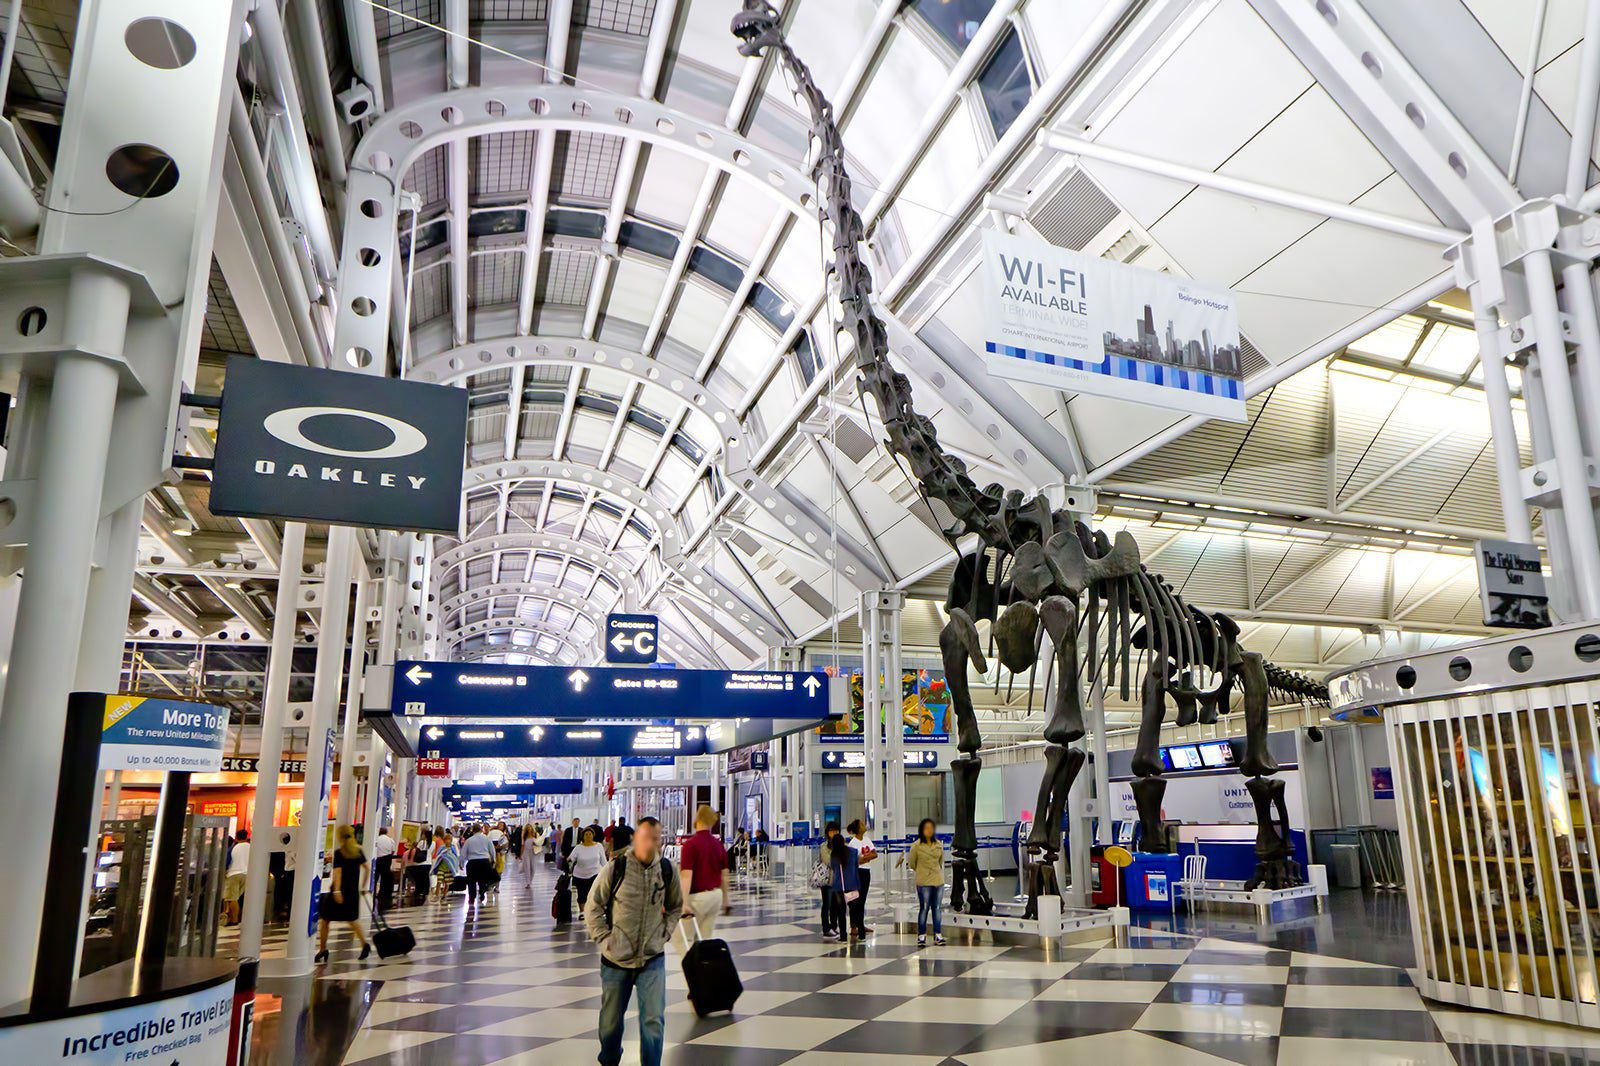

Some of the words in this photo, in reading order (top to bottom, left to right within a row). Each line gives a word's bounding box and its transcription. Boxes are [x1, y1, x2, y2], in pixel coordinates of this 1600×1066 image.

[1000, 253, 1086, 299] WI-FI
[1001, 285, 1088, 316] AVAILABLE
[1178, 293, 1201, 305] Boingo
[1203, 299, 1229, 311] Hotspot
[1001, 303, 1055, 322] TERMINAL
[1024, 332, 1066, 346] INTERNATIONAL
[255, 459, 426, 490] OAKLEY
[1483, 551, 1496, 568] The
[1497, 552, 1512, 569] Field
[611, 620, 655, 629] Concourse
[634, 632, 654, 654] C
[458, 675, 513, 685] Concourse
[614, 679, 641, 688] Gates
[108, 702, 132, 721] NEW
[163, 709, 201, 727] More
[204, 713, 216, 728] To
[127, 728, 144, 737] The
[146, 730, 165, 738] new
[166, 730, 190, 739] United
[127, 756, 140, 765] Up
[153, 757, 180, 766] 40,000
[221, 758, 252, 771] CKS
[421, 761, 446, 769] FREE
[1224, 788, 1248, 797] UNIT
[1228, 801, 1254, 809] Customer
[62, 1019, 176, 1057] Incredible
[180, 1001, 218, 1030] Travel
[125, 1048, 149, 1062] Free
[150, 1039, 187, 1056] Checked
[188, 1033, 203, 1044] Bag
